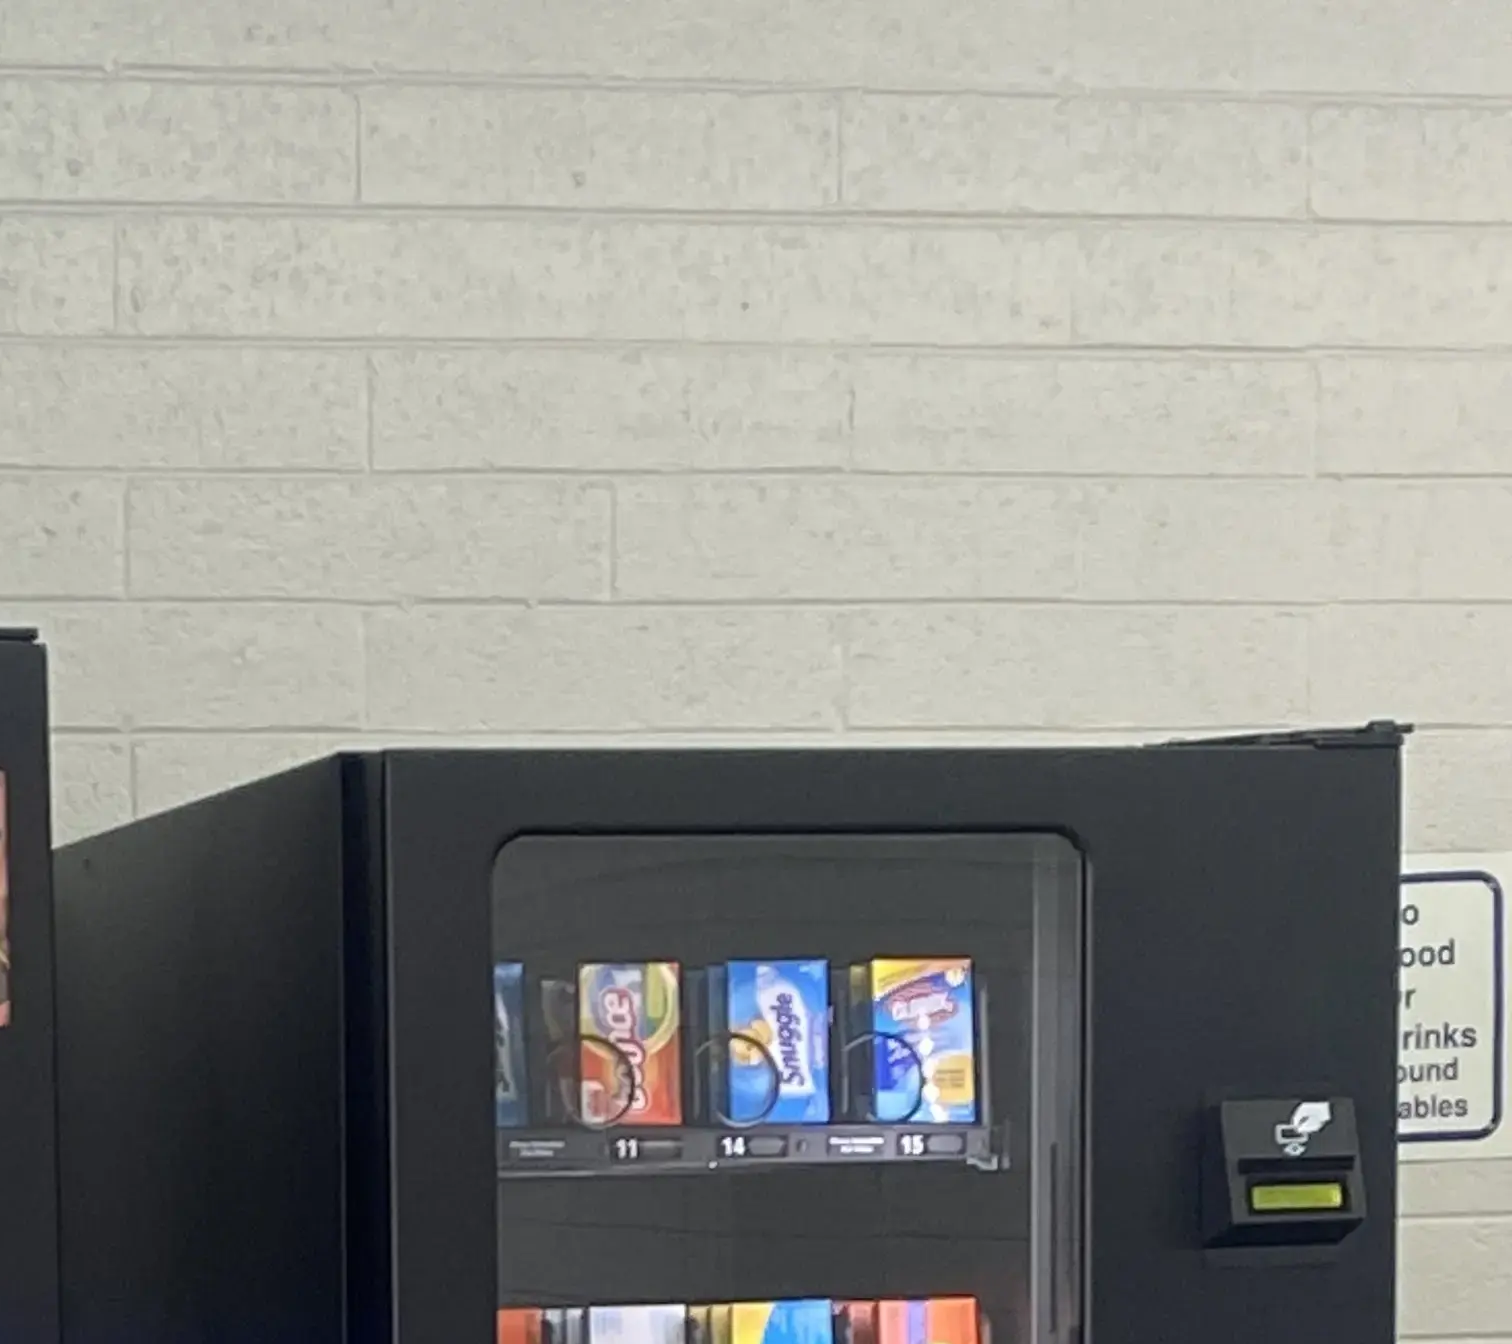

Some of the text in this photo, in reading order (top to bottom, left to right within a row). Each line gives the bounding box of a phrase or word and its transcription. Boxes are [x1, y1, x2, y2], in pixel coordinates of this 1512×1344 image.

[1401, 904, 1419, 925] o
[1400, 938, 1456, 967] ood
[775, 992, 805, 1087] Snuggle
[1403, 1022, 1477, 1050] rinks
[1397, 1057, 1458, 1083] ound
[1398, 1096, 1468, 1120] ables
[616, 1139, 638, 1158] 11
[722, 1136, 745, 1155] 14
[900, 1134, 924, 1155] 15
